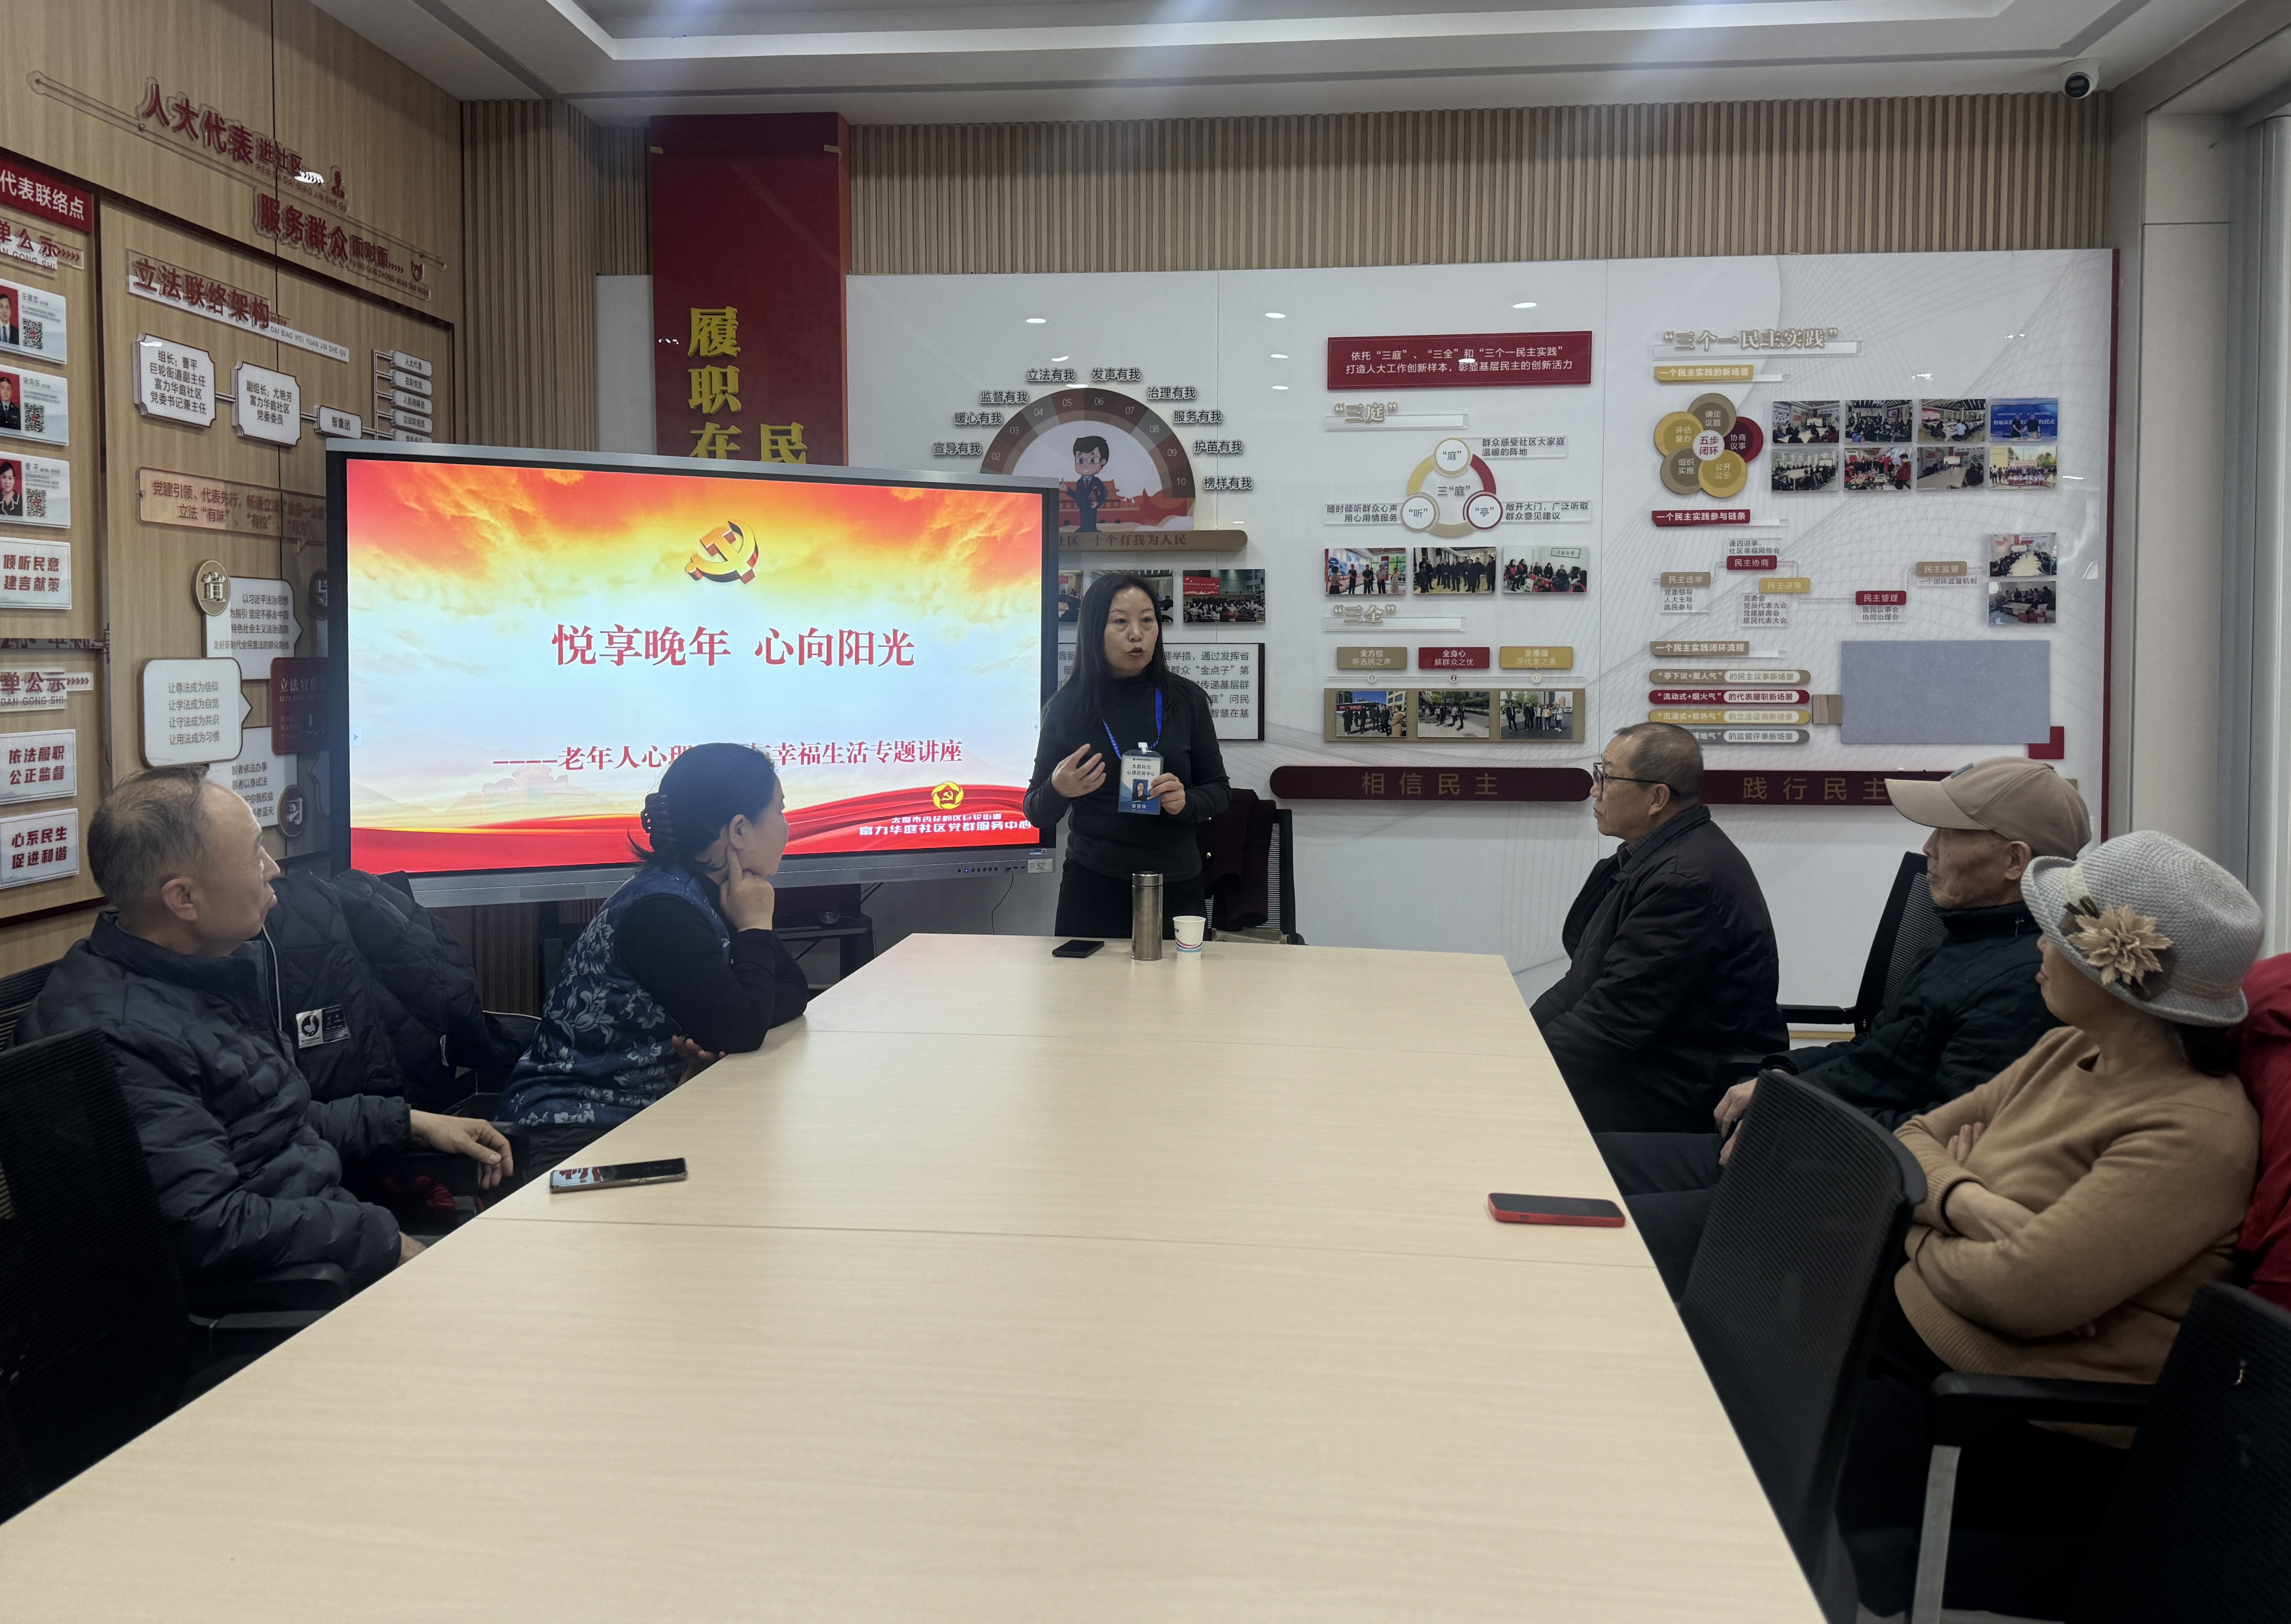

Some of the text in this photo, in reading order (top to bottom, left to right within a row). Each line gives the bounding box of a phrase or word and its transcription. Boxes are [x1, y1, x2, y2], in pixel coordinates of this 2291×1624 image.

[0, 169, 84, 221] 代表联络点
[135, 259, 269, 329] 立法联络架构
[271, 326, 279, 334] DAI
[281, 330, 293, 339] BIAO
[294, 334, 304, 343] WEI
[306, 338, 318, 347] YUAN
[329, 346, 338, 354] SHE
[1664, 328, 1839, 351] “三个一民主实践”
[1351, 346, 1563, 361] 依托“三庭”、“三全”和“三个一民主实践”
[405, 357, 422, 371] 人大代表
[1345, 360, 1573, 374] 打造人大工作创新样本，彰显基层民主的创新活力
[150, 362, 206, 387] 巨轮街道副主任
[1027, 368, 1075, 381] 立法有我
[1092, 367, 1141, 381] 发声有我
[1659, 367, 1749, 377] 一个民主实践的新场景
[154, 377, 202, 400] 富力华庭社区
[1147, 386, 1196, 400] 治理有我
[150, 391, 206, 415] 党委书记兼主任
[980, 390, 1029, 404] 监督有我
[1062, 398, 1072, 407] 05
[1094, 397, 1104, 405] 06
[249, 394, 290, 414] 富力华庭社区
[1125, 406, 1135, 415] 07
[257, 409, 283, 426] 党委委员
[954, 412, 1004, 425] 暖心有我
[1034, 408, 1043, 417] 04
[1173, 410, 1223, 424] 服务有我
[1334, 402, 1398, 423] “三庭”
[332, 416, 350, 431] 智囊团
[1149, 425, 1159, 433] 08
[1010, 426, 1019, 435] 03
[1194, 440, 1243, 454] 护苗有我
[1482, 436, 1565, 447] 群众感受社区大家庭
[933, 442, 982, 456] 宣导有我
[1167, 448, 1177, 457] 09
[1442, 450, 1462, 460] “庭”
[1482, 447, 1528, 456] 温暖的阵地
[1699, 447, 1718, 455] 闭环
[991, 452, 1001, 461] 02
[1176, 478, 1186, 486] 10
[1203, 476, 1253, 490] 榜样有我
[1437, 485, 1471, 497] 三“庭”
[1326, 504, 1398, 514] 随时倾听群众心声
[1475, 506, 1494, 516] “亭”
[1505, 501, 1589, 511] 敞开大门，广泛听取
[1344, 513, 1398, 522] 用心用情服务
[1408, 508, 1428, 518] “听”
[1505, 510, 1560, 520] 群众意见建议
[1657, 512, 1746, 521] 一个民主实践参与链条
[1095, 533, 1186, 546] 十个有我为人民
[3, 554, 60, 572] 倾听民意
[1735, 559, 1769, 567] 民主协商
[1924, 565, 1959, 574] 民主监督
[4, 576, 60, 592] 建言献策
[1668, 575, 1703, 584] 民主选举
[1767, 581, 1802, 590] 民主决策
[243, 594, 288, 606] 以习近平法治思想
[1863, 594, 1899, 602] 民主管理
[249, 610, 289, 620] 坚定不移走中国
[1333, 604, 1396, 624] “三全”
[231, 623, 289, 635] 特色社会主义法治道路
[551, 623, 915, 667] 悦享晚年 心向阳光
[1655, 643, 1745, 652] 一个民主实践闭环流程
[1360, 649, 1384, 657] 全方位
[1442, 649, 1466, 657] 全身心
[1352, 657, 1391, 666] 听选民之声
[1434, 657, 1474, 667] 解群众之忧
[168, 681, 219, 694] 让尊法成为信仰
[22, 696, 47, 705] GONG
[51, 696, 64, 704] SHI
[1658, 692, 1722, 701] “流动式+烟火气”
[168, 697, 219, 711] 让学法成为自觉
[169, 714, 219, 728] 让守法成为共识
[169, 731, 219, 746] 让用法成为习惯
[9, 745, 65, 765] 依法履职
[10, 765, 65, 785] 公正监督
[232, 762, 267, 775] 智者依法办事
[232, 776, 268, 790] 愚者以身试法
[1361, 772, 1499, 796] 相信民主
[1743, 777, 1887, 801] 践行民主
[859, 820, 1032, 836] 富力华庭社区党群服务中心
[11, 826, 67, 848] 心系民生
[12, 846, 67, 869] 促进和谐
